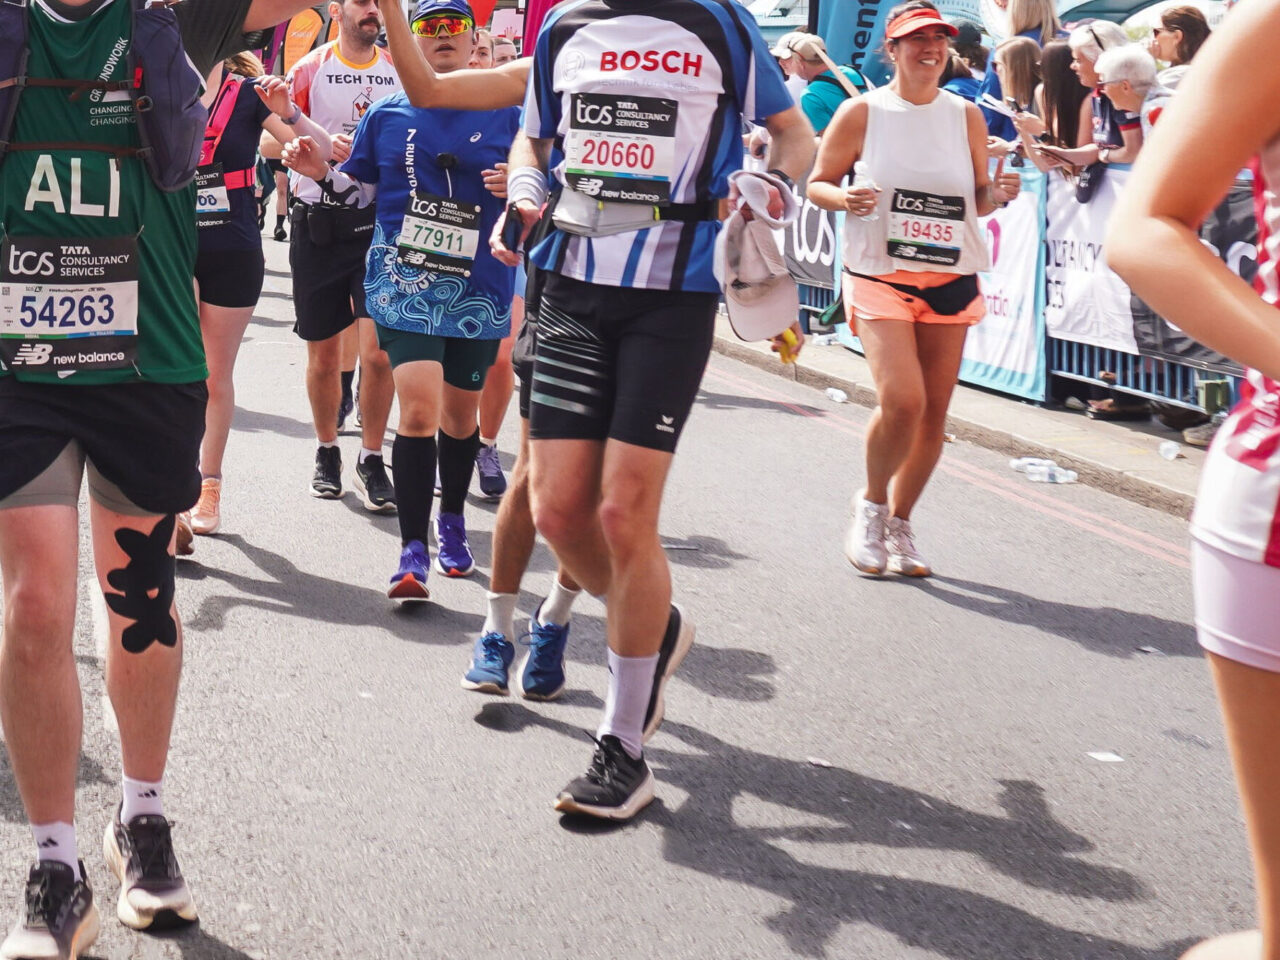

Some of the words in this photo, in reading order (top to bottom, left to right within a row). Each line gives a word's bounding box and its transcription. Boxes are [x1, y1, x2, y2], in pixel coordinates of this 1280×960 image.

[600, 50, 703, 77] BOSCH
[326, 74, 362, 84] TECH
[366, 75, 395, 86] TOM
[89, 105, 133, 115] CHANGING
[616, 101, 639, 110] TATA
[576, 99, 612, 125] tcs
[615, 109, 671, 122] CONSULTANCY
[90, 116, 137, 127] CHANGING
[615, 120, 649, 129] SERVICES
[406, 128, 417, 142] 7
[581, 139, 655, 170] 20660
[24, 154, 121, 218] ALI
[601, 190, 620, 199] new
[620, 191, 660, 202] balance
[411, 196, 439, 217] tcs
[441, 201, 458, 209] TATA
[896, 193, 924, 212] tcs
[438, 213, 463, 223] SERVICES
[439, 207, 475, 220] CONSULTANCY
[901, 220, 953, 242] 19435
[413, 224, 464, 252] 77911
[60, 246, 91, 255] TATA
[8, 244, 55, 276] tcs
[60, 254, 130, 266] CONSULTANCY
[60, 267, 105, 276] SERVICES
[424, 261, 439, 269] new
[438, 263, 465, 273] balance
[20, 294, 115, 328] 54263
[53, 355, 77, 364] new
[78, 352, 125, 363] balance
